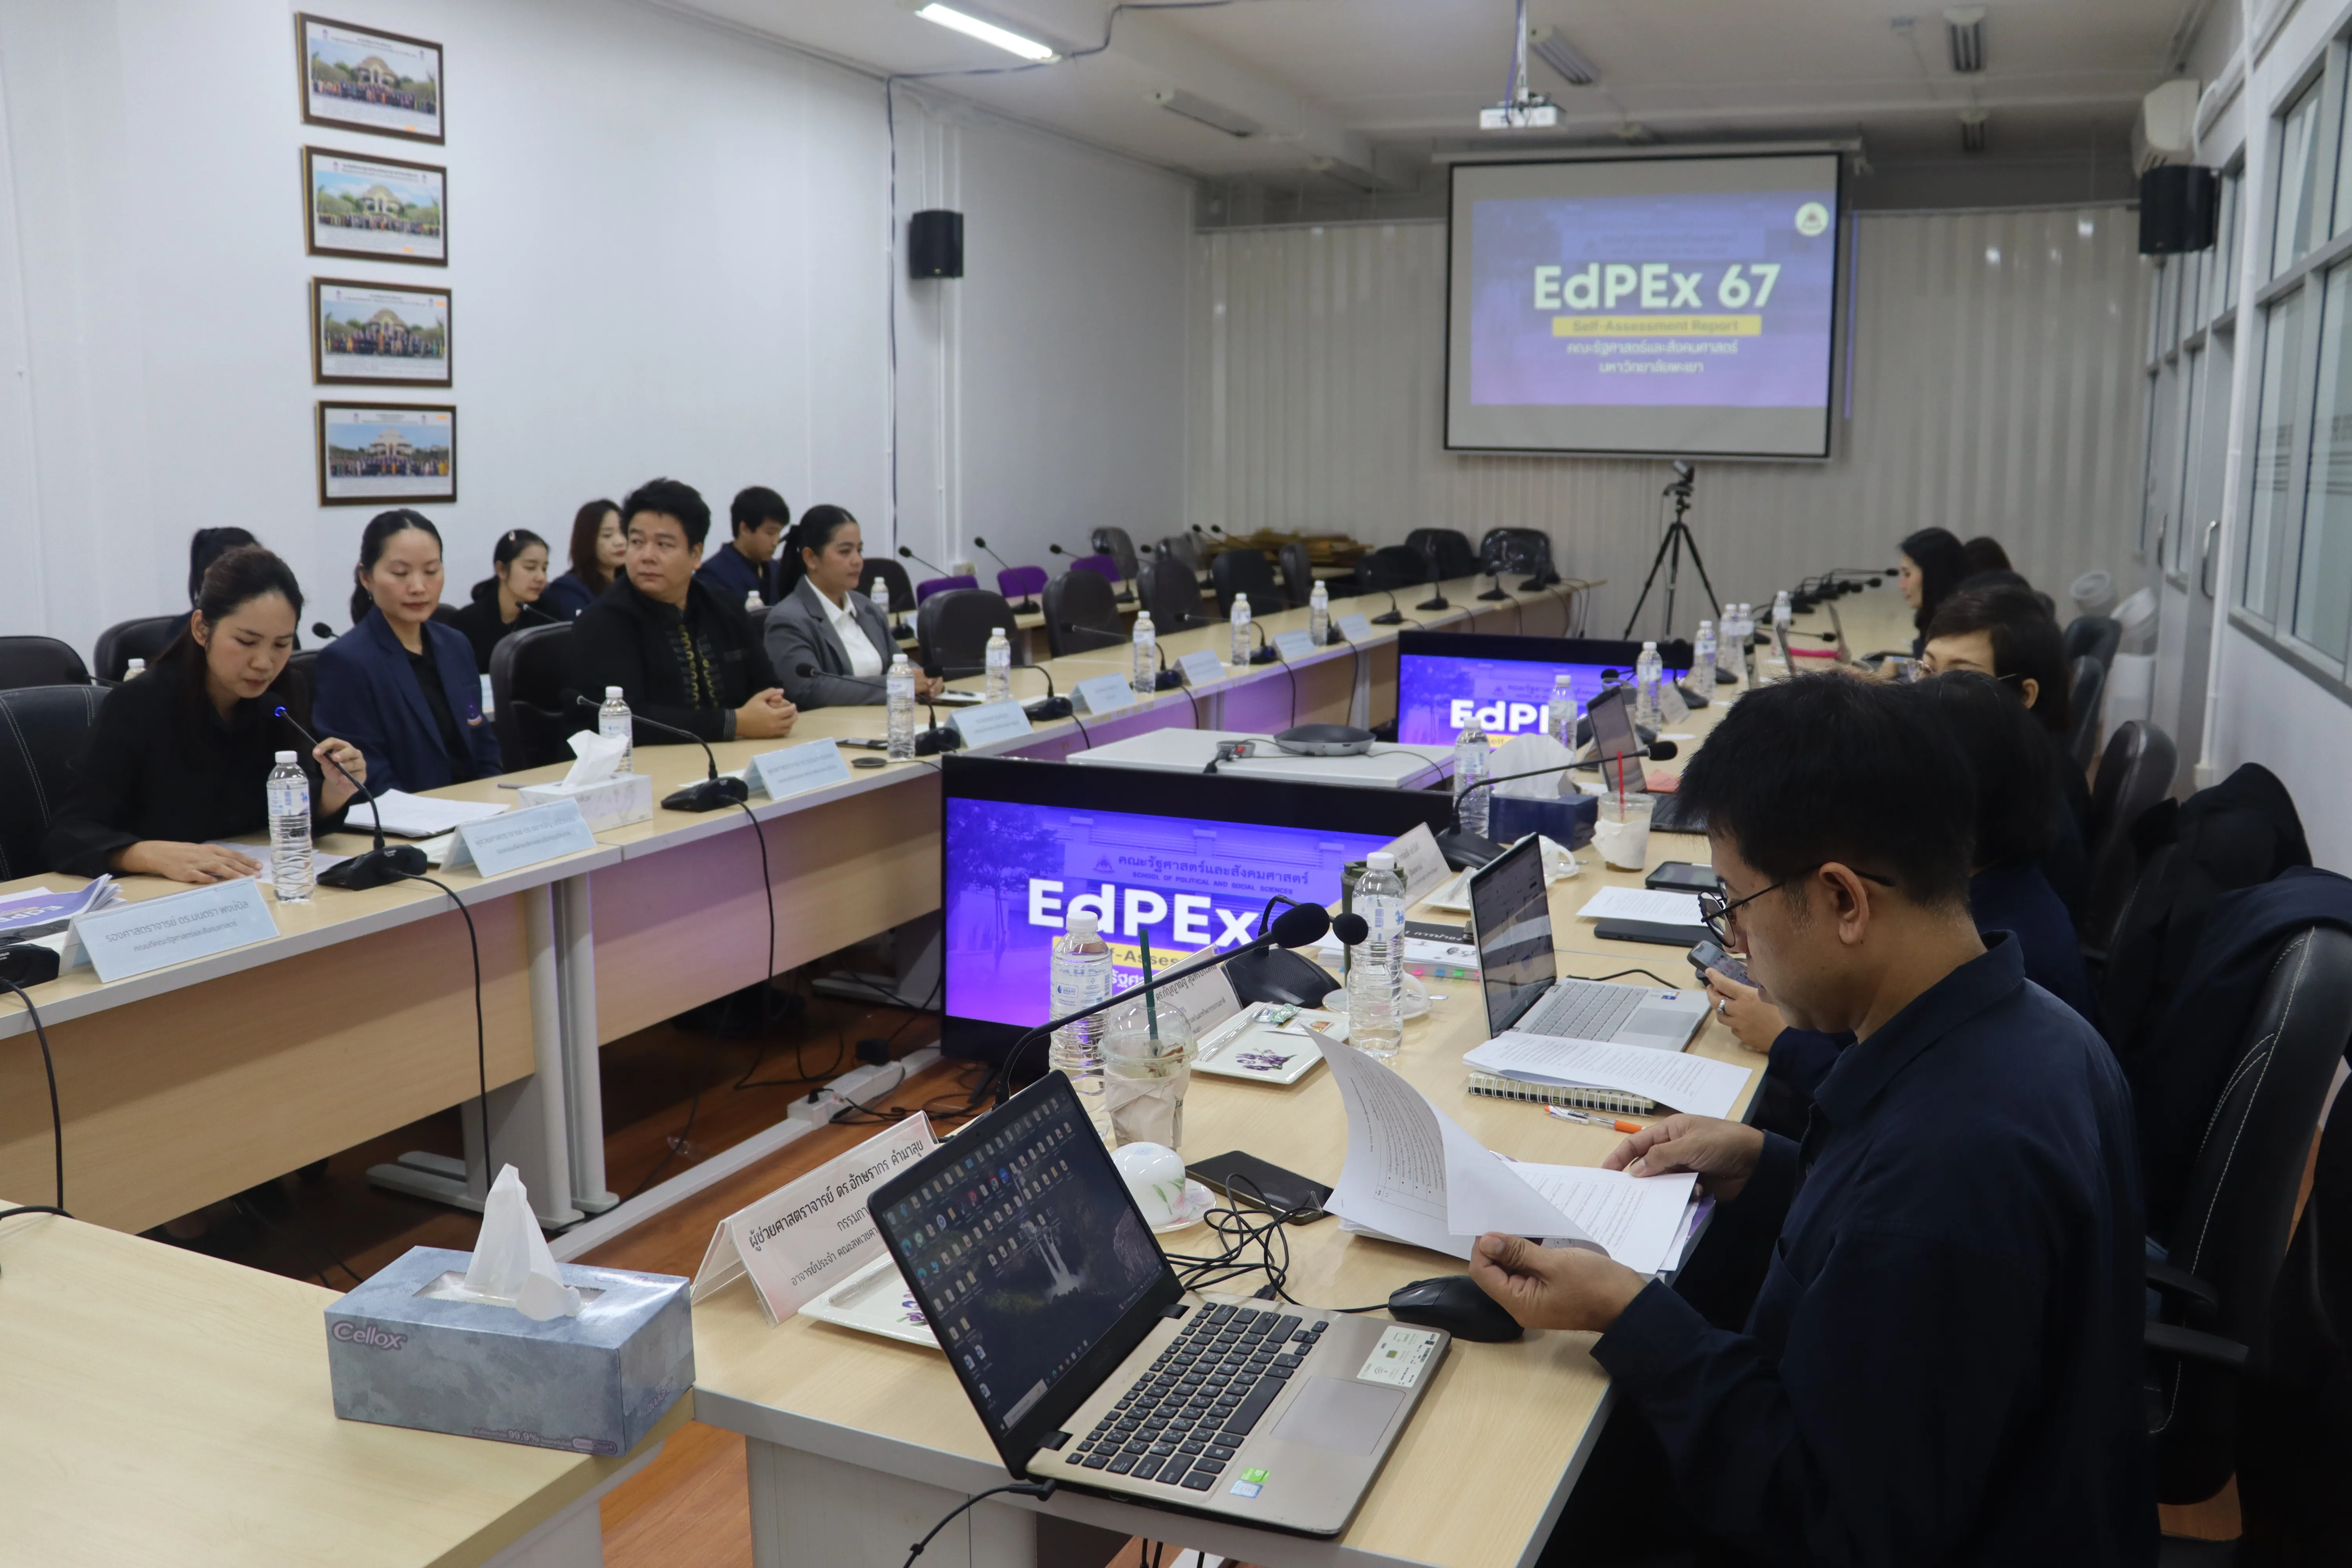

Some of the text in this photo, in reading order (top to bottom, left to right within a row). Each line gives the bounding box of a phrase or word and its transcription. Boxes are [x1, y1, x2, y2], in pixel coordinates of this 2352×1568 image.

[1534, 263, 1781, 309] EdPEx 67
[1573, 319, 1739, 332] Self-Assessment Report
[1118, 854, 1309, 886] คณะรัฐศาสตร์และสังคมศาสตร์
[1132, 871, 1160, 880] SCHOOL
[1176, 876, 1210, 886] POLITICAL
[1231, 882, 1256, 891] SOCIAL
[1259, 886, 1293, 895] SCIENCES
[1029, 878, 1259, 947] EdPEx
[105, 916, 176, 943] รองศาสตราจารย์
[748, 1139, 925, 1251] ผู้ช่วยศาสตราจารย์ ดร.อักษรากร คำมาสุข
[836, 1205, 870, 1232] กรรมกา
[791, 1226, 878, 1286] อาจารย์ประจำ คณะสหเวชศา
[334, 1322, 401, 1348] Cellox
